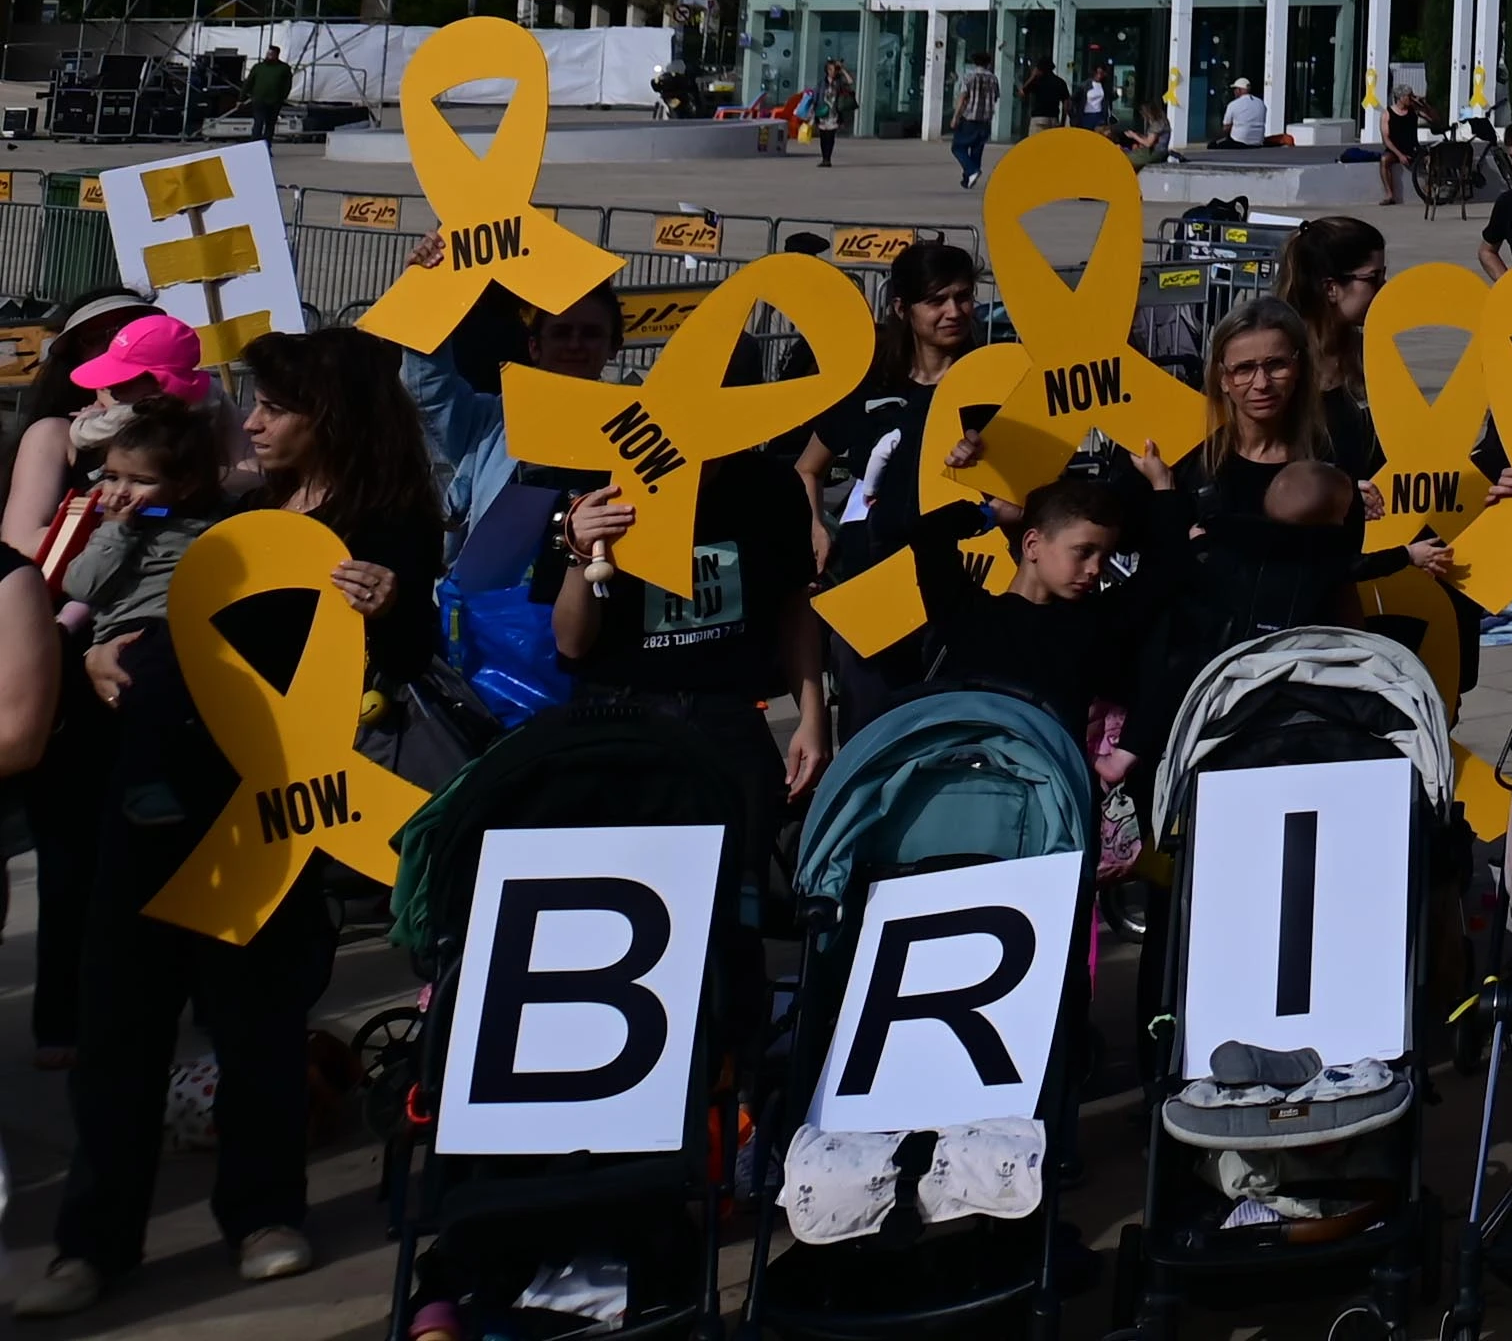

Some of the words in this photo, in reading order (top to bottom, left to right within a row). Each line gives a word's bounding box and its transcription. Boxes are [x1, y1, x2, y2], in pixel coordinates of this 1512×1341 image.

[451, 217, 529, 271] NOW.
[1044, 356, 1132, 416] NOW.
[601, 401, 686, 493] NOW.
[1391, 471, 1464, 514] NOW.
[256, 770, 362, 845] NOW.
